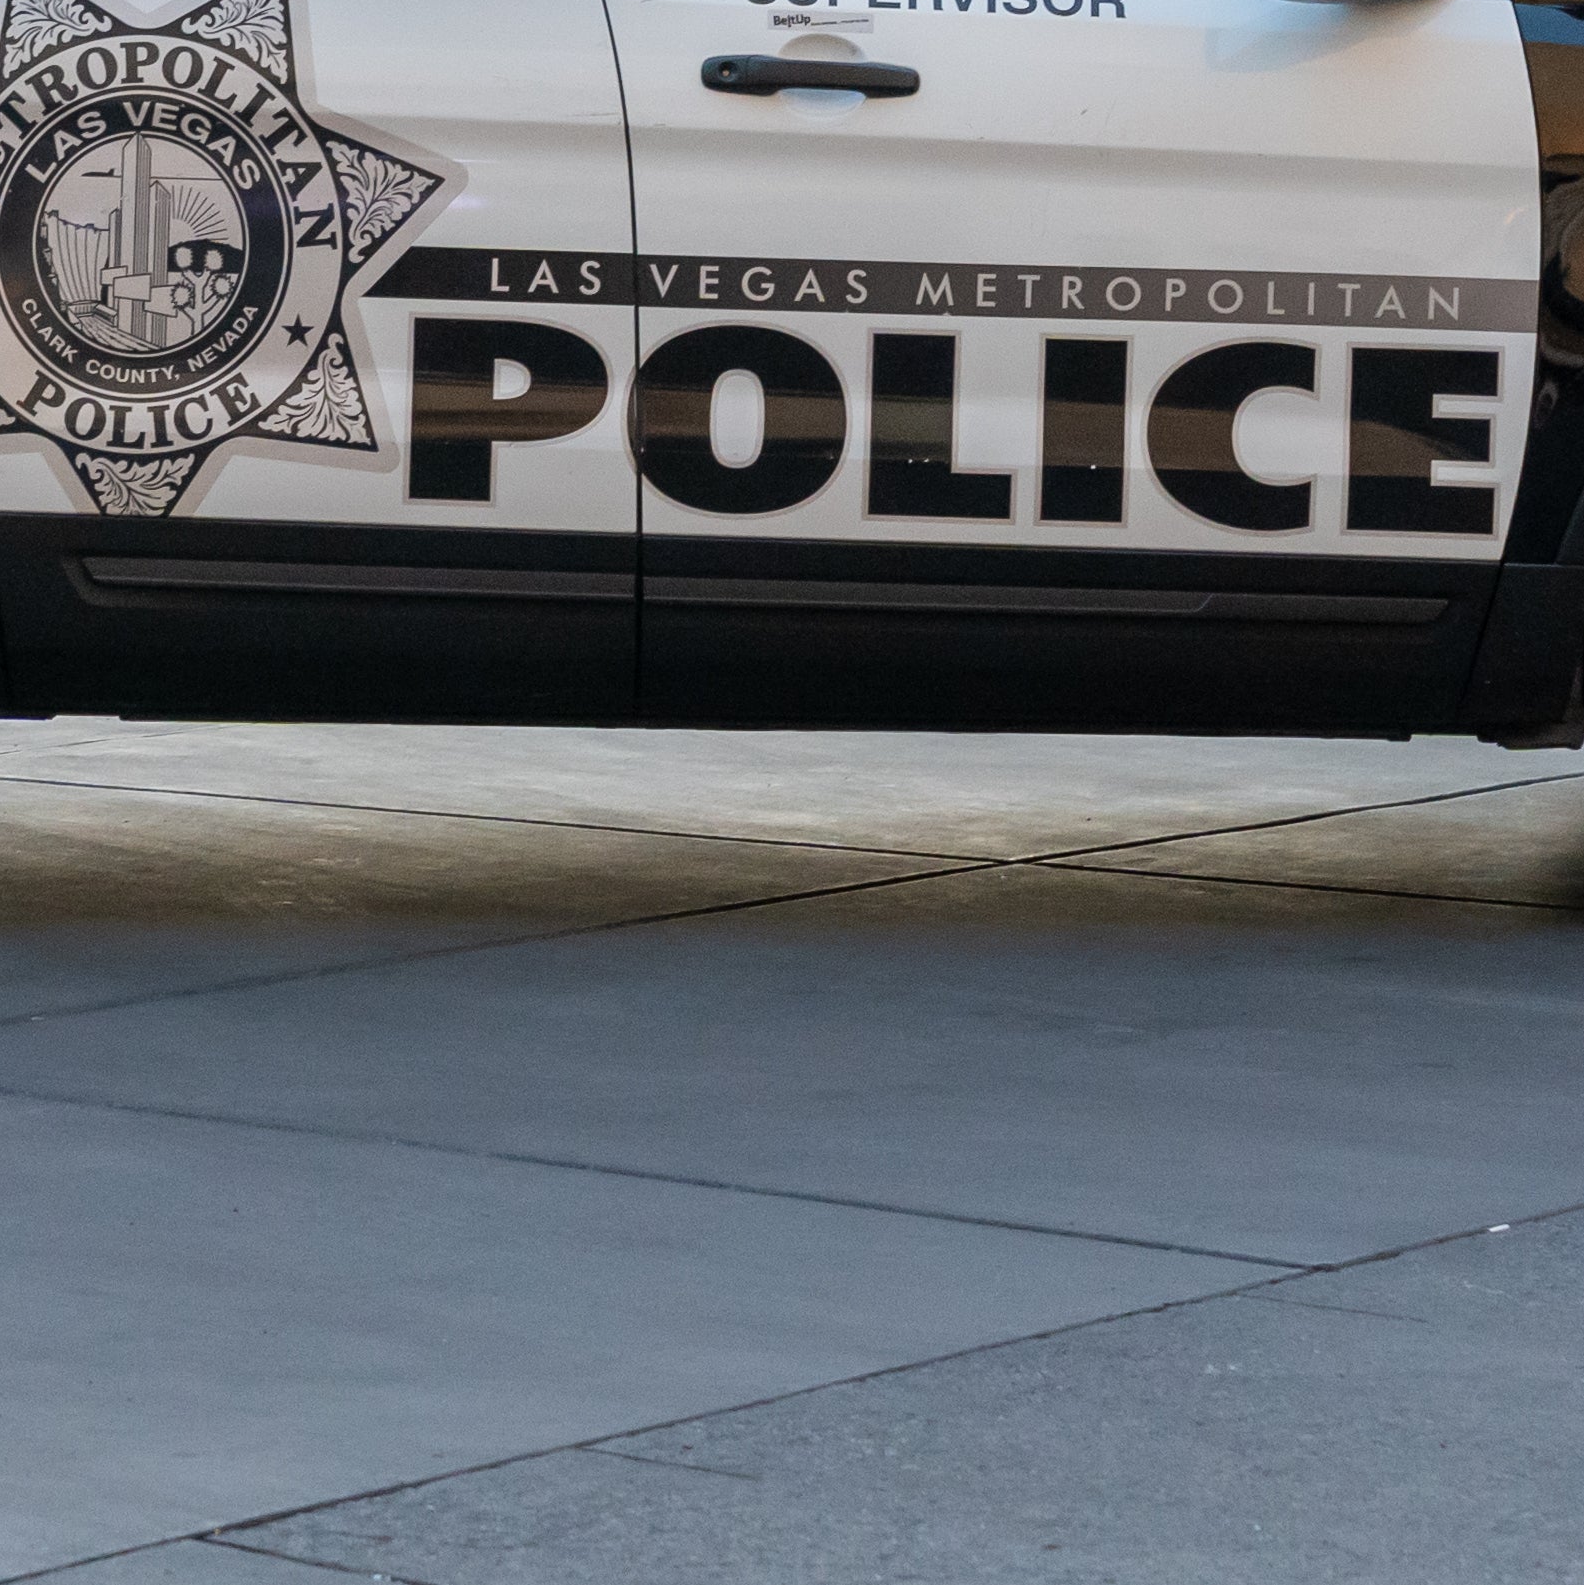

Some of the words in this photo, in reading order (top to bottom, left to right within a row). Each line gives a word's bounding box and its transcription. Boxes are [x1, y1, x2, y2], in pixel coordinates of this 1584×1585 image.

[25, 111, 107, 185] LAS
[122, 101, 262, 190] VEGAS
[490, 257, 602, 296] LAS
[649, 262, 869, 306] VEGAS
[915, 271, 1461, 321] METROPOLITAN
[21, 298, 79, 364] CLARK
[85, 359, 181, 384] COUNTY,
[187, 305, 259, 372] NEVADA
[16, 370, 263, 450] POLICE
[404, 312, 1505, 540] POLICE
